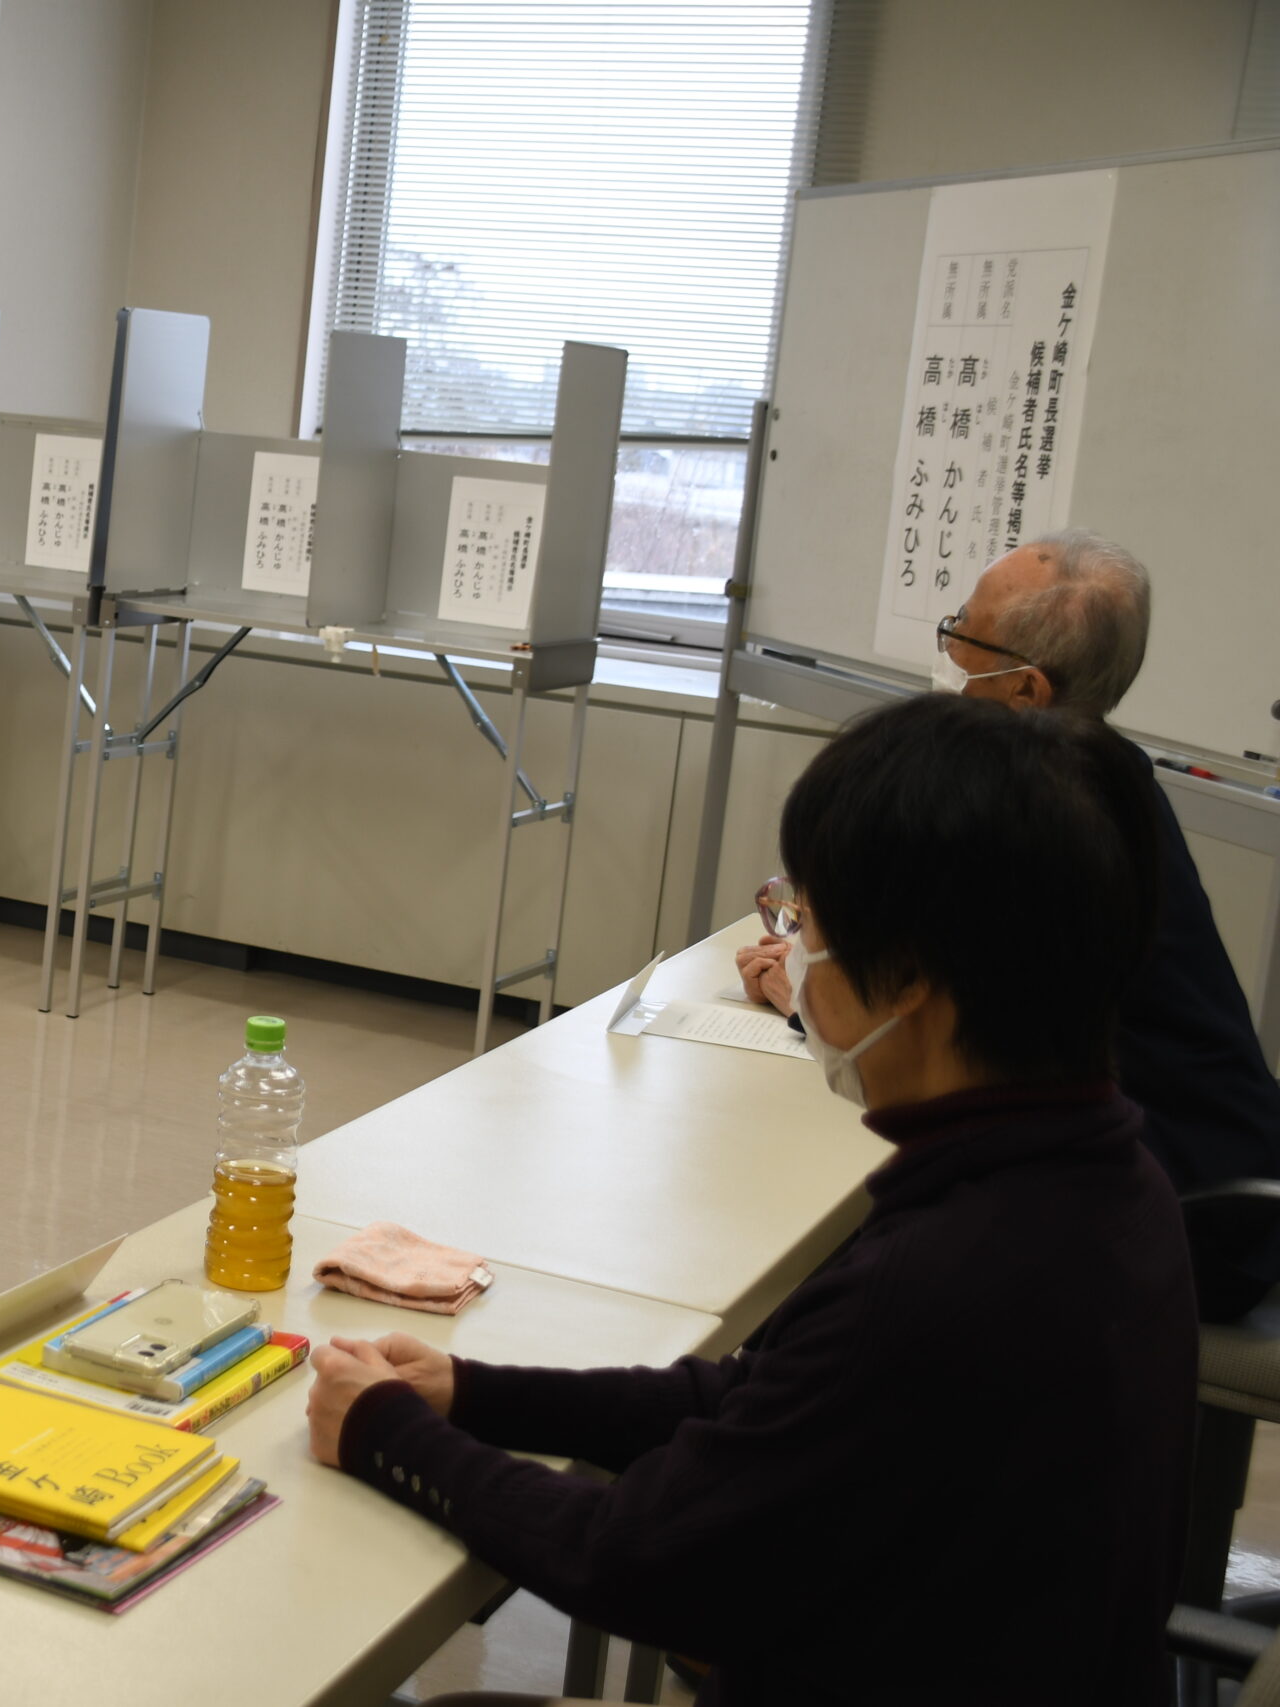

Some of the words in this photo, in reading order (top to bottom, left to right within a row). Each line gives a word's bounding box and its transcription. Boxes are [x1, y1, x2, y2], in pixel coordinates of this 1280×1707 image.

[1036, 282, 1077, 480] 金ケ崎町長選挙
[94, 1443, 181, 1488] Book
